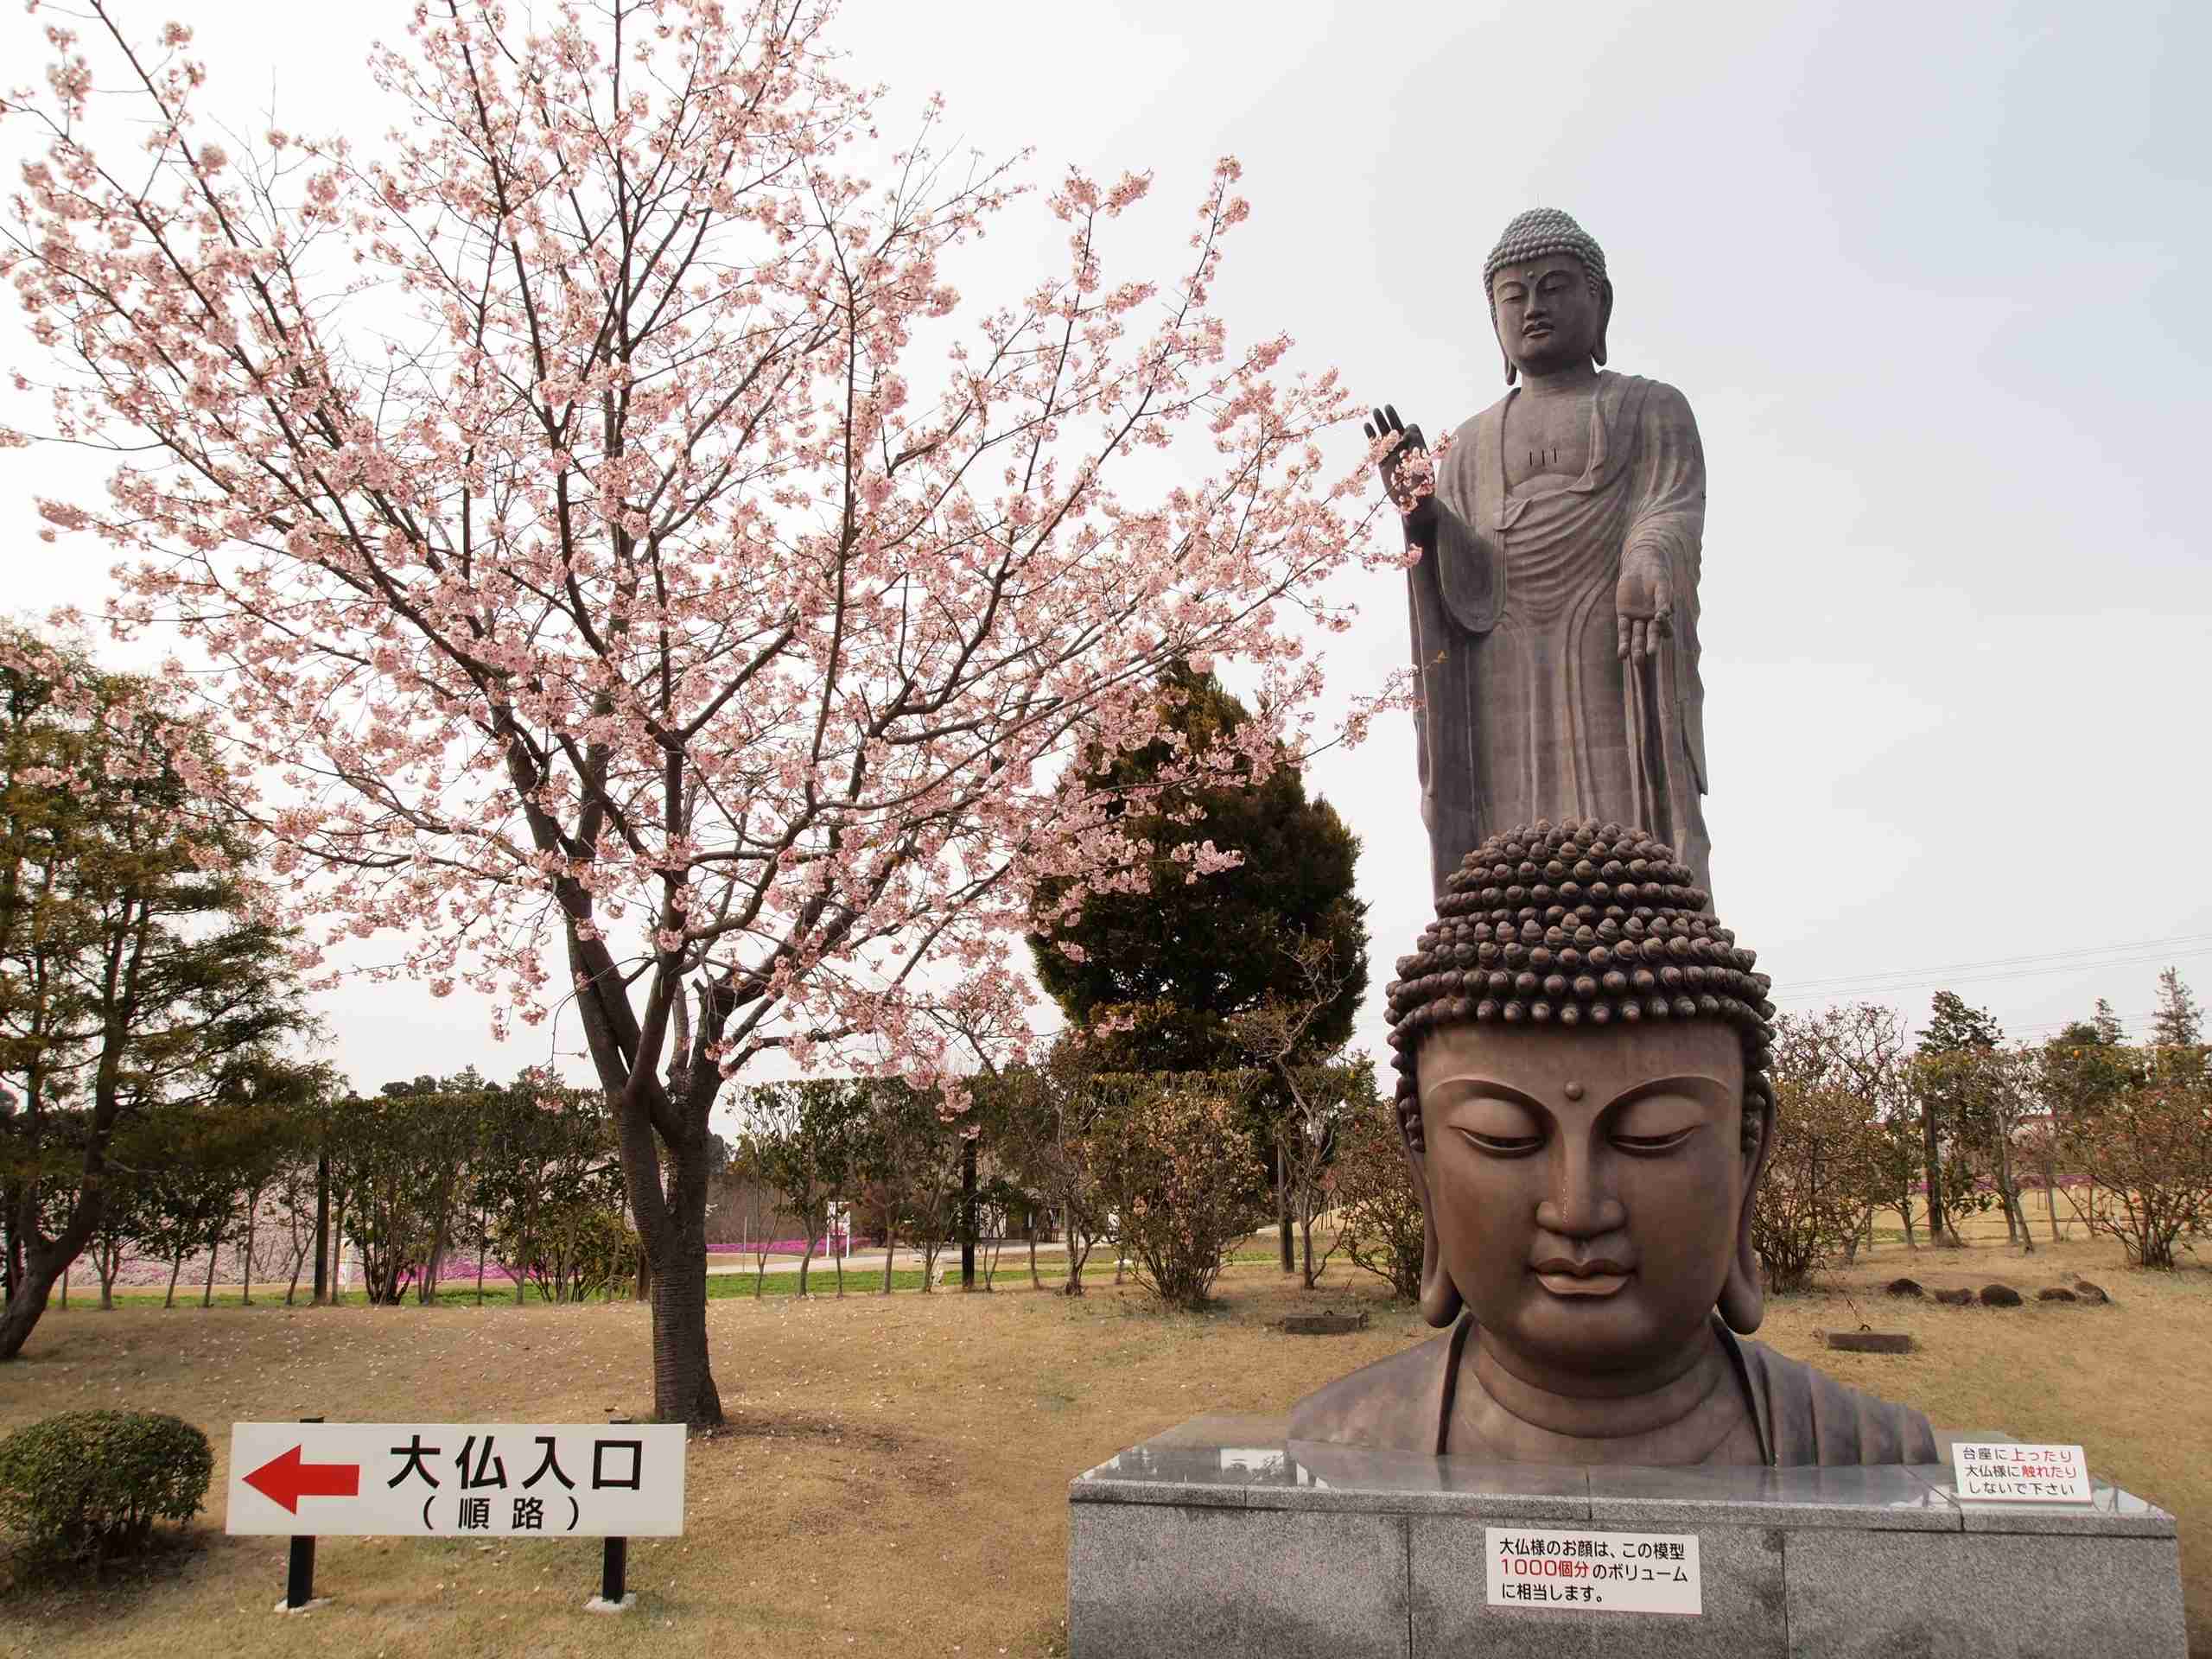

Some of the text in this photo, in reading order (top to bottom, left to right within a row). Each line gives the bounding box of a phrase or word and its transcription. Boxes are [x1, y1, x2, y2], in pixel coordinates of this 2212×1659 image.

[386, 1434, 643, 1491] 大仏入口
[1962, 1447, 2071, 1463] 台座に上ったり
[1966, 1465, 2076, 1478] 大仏様に触れたり
[1969, 1481, 2075, 1496] しないで下さい
[1499, 1538, 1685, 1560] 大仏様のお顔は、この模型
[1502, 1583, 1603, 1603] に相当します。
